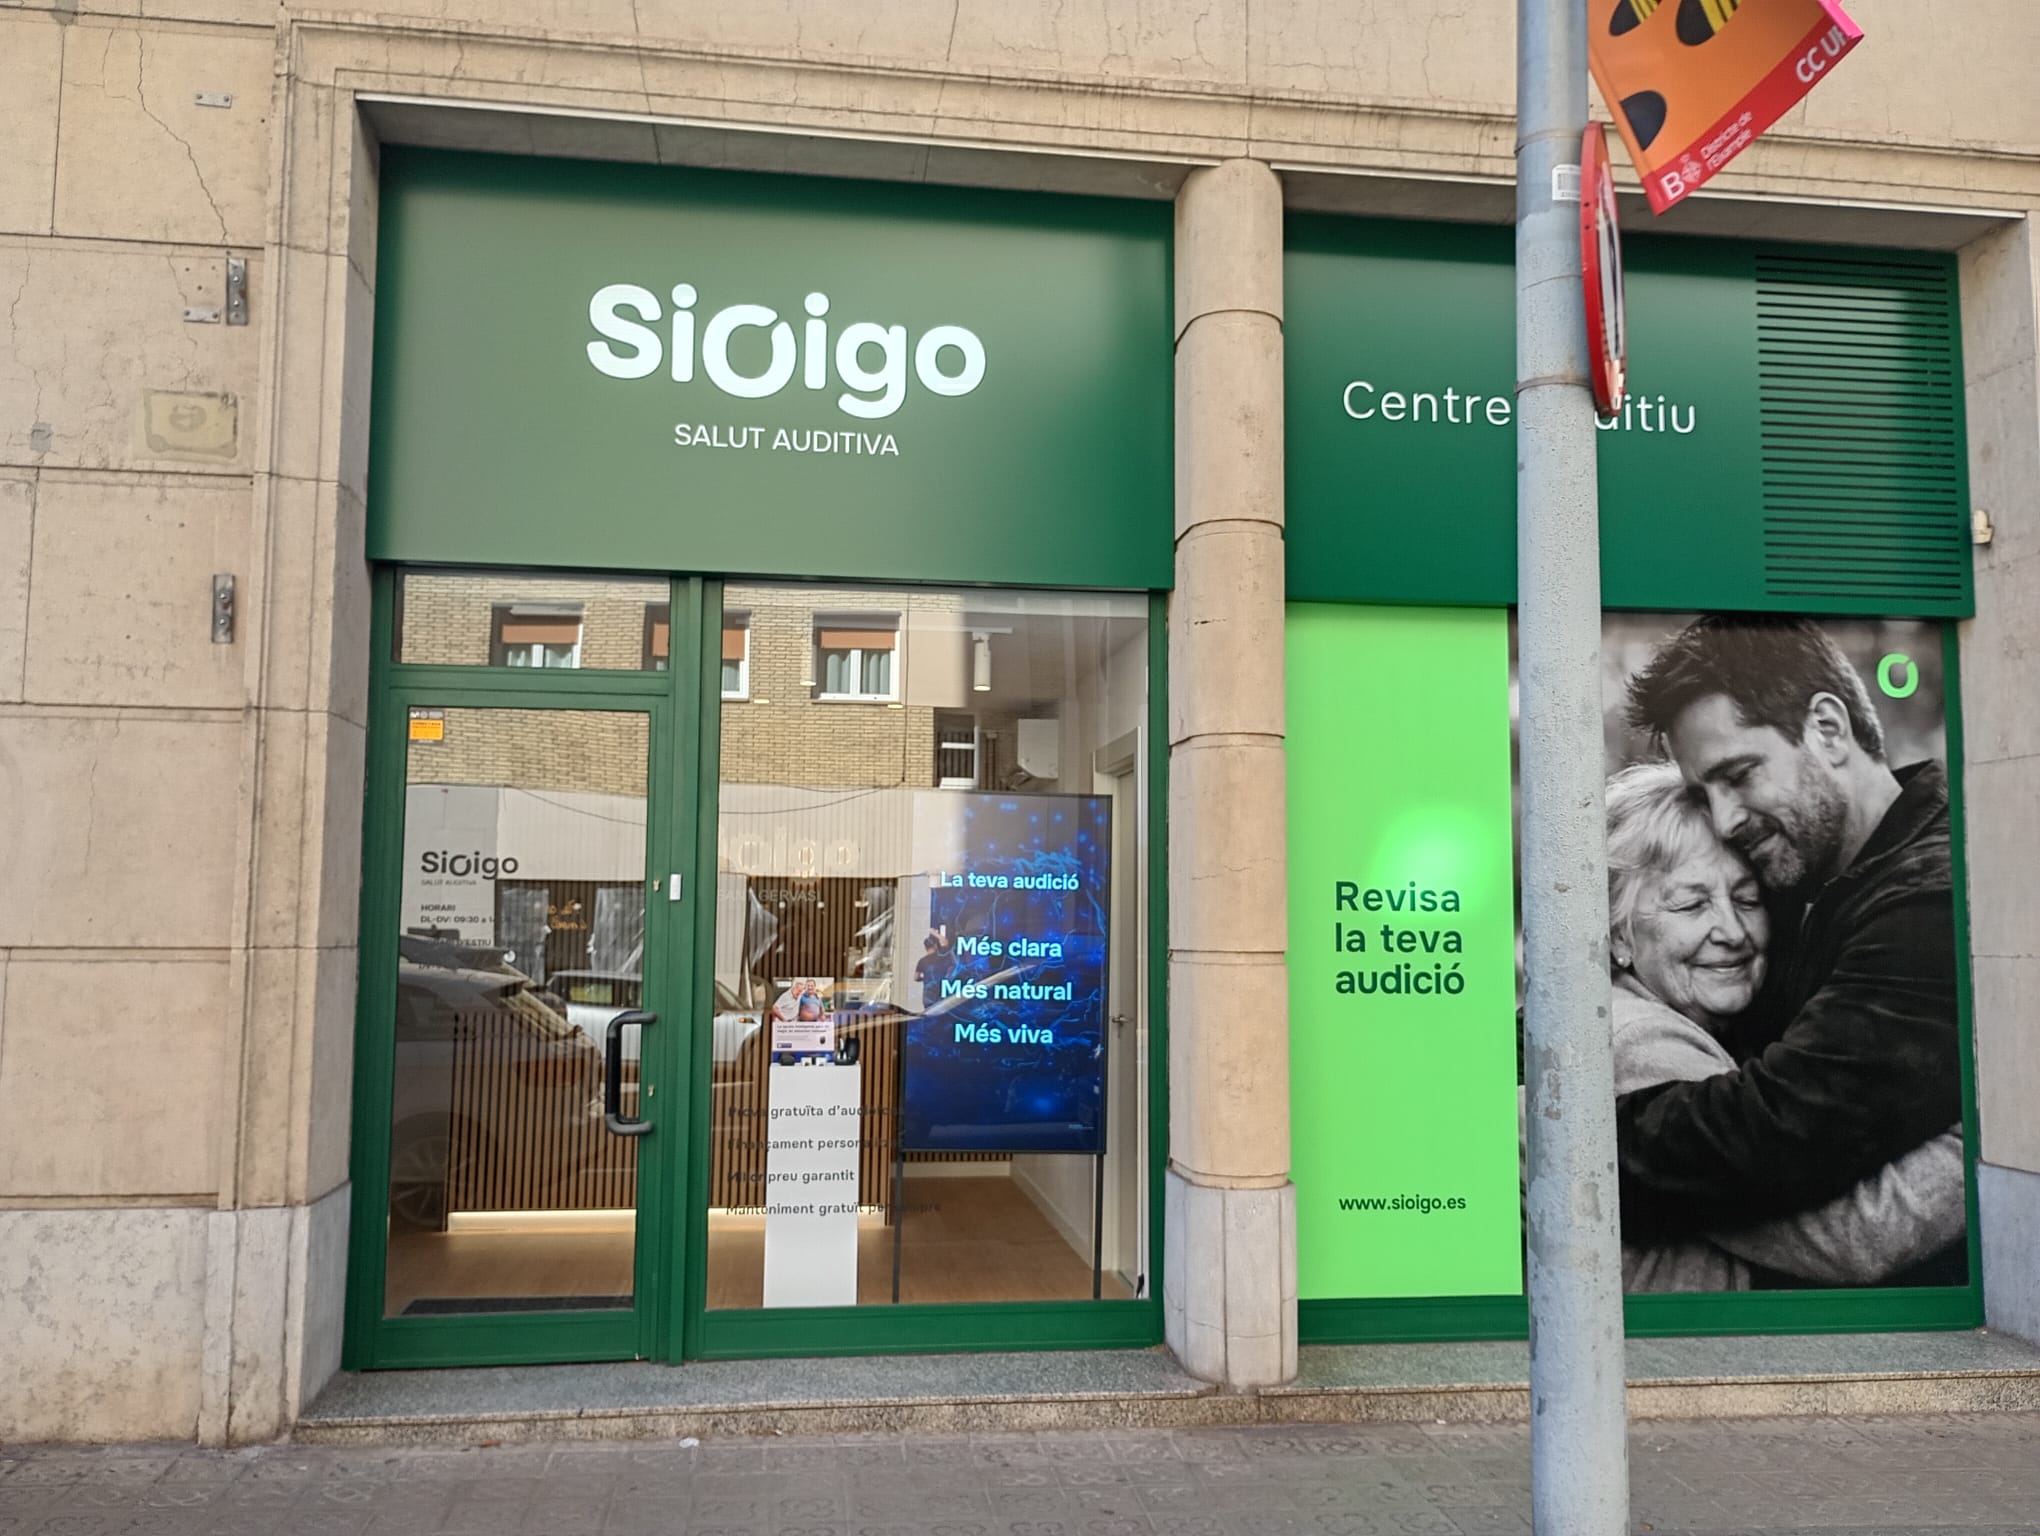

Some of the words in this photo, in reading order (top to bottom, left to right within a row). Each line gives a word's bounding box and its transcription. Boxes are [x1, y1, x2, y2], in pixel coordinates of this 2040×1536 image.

[1796, 47, 1826, 83] CC
[1343, 381, 1511, 425] Centre
[674, 423, 765, 449] SALUT
[772, 428, 899, 456] AUDITIVA
[941, 871, 963, 887] La
[968, 872, 1008, 889] teva
[1013, 872, 1079, 891] audició
[1335, 881, 1460, 912] Revisa
[957, 936, 1002, 956] Més
[1008, 938, 1062, 958] clara
[1335, 922, 1366, 953] la
[1380, 924, 1463, 954] teva
[941, 978, 987, 999] Més
[994, 982, 1073, 1001] natural
[1335, 962, 1465, 995] audició
[955, 1022, 1001, 1043] Més
[1008, 1024, 1053, 1044] viva
[770, 1104, 824, 1120] gratuïta
[768, 1172, 798, 1184] preu
[802, 1169, 855, 1184] garantit
[1338, 1194, 1467, 1214] www.sioigo.es
